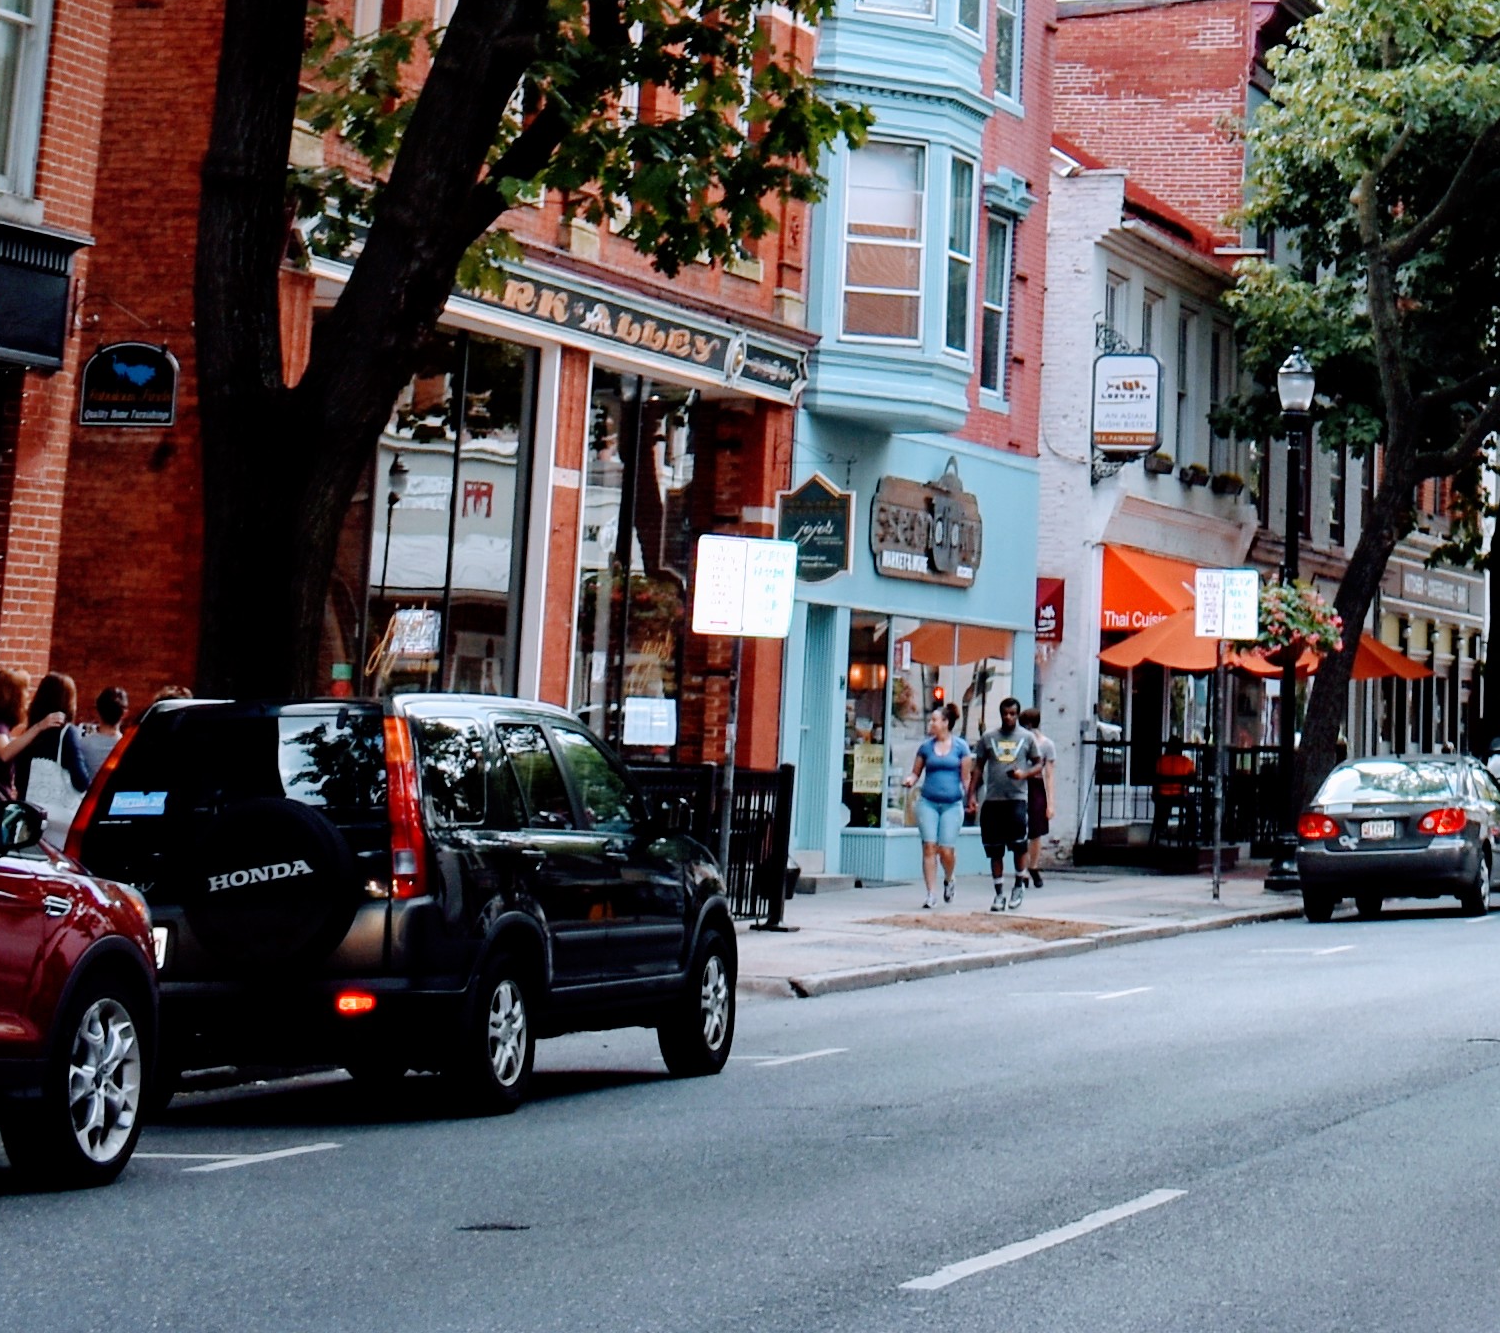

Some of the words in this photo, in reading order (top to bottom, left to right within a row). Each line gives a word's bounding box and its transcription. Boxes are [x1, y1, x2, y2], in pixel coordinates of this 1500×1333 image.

[581, 304, 720, 362] ALLEY
[1104, 610, 1130, 627] Thai
[1132, 610, 1169, 628] Cuisi
[208, 859, 313, 892] HONDA
